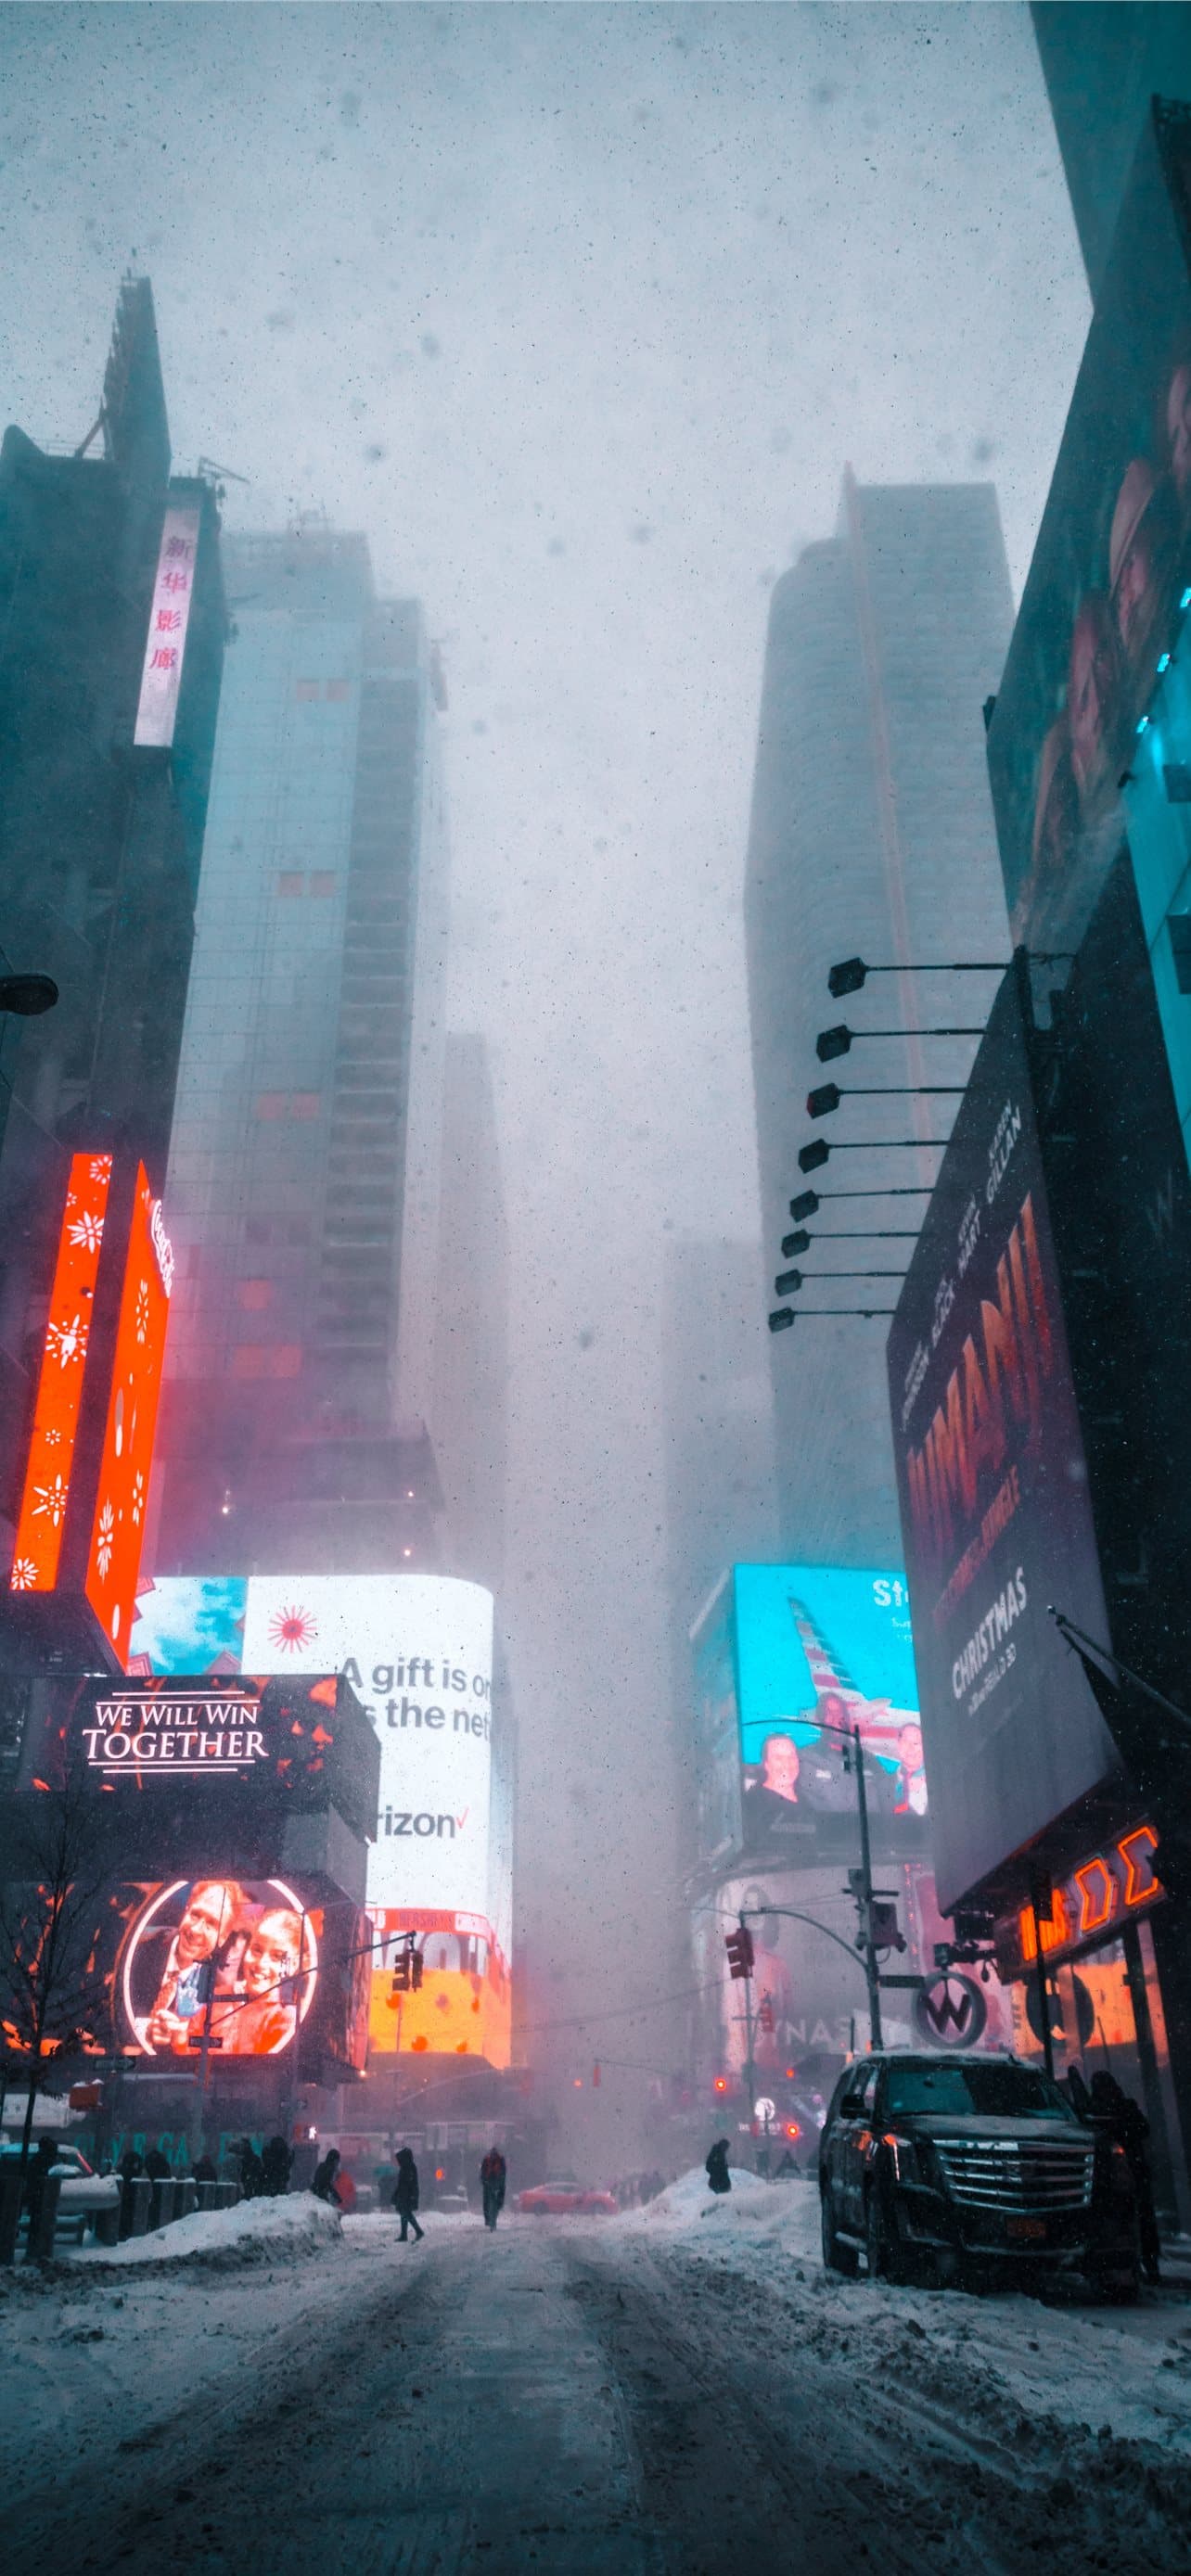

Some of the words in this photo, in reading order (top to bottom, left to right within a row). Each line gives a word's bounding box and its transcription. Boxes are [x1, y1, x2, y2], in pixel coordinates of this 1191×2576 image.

[985, 1104, 1021, 1205] GILLAN
[952, 1567, 1027, 1700] CHRISTMAS
[341, 1657, 364, 1688] A
[372, 1657, 434, 1694] gift
[442, 1659, 467, 1692] is
[96, 1705, 132, 1726] WE
[140, 1704, 198, 1726] WILL
[205, 1703, 258, 1725] WIN
[385, 1696, 445, 1729] the
[82, 1728, 269, 1759] TOGETHER
[923, 1993, 971, 2034] W
